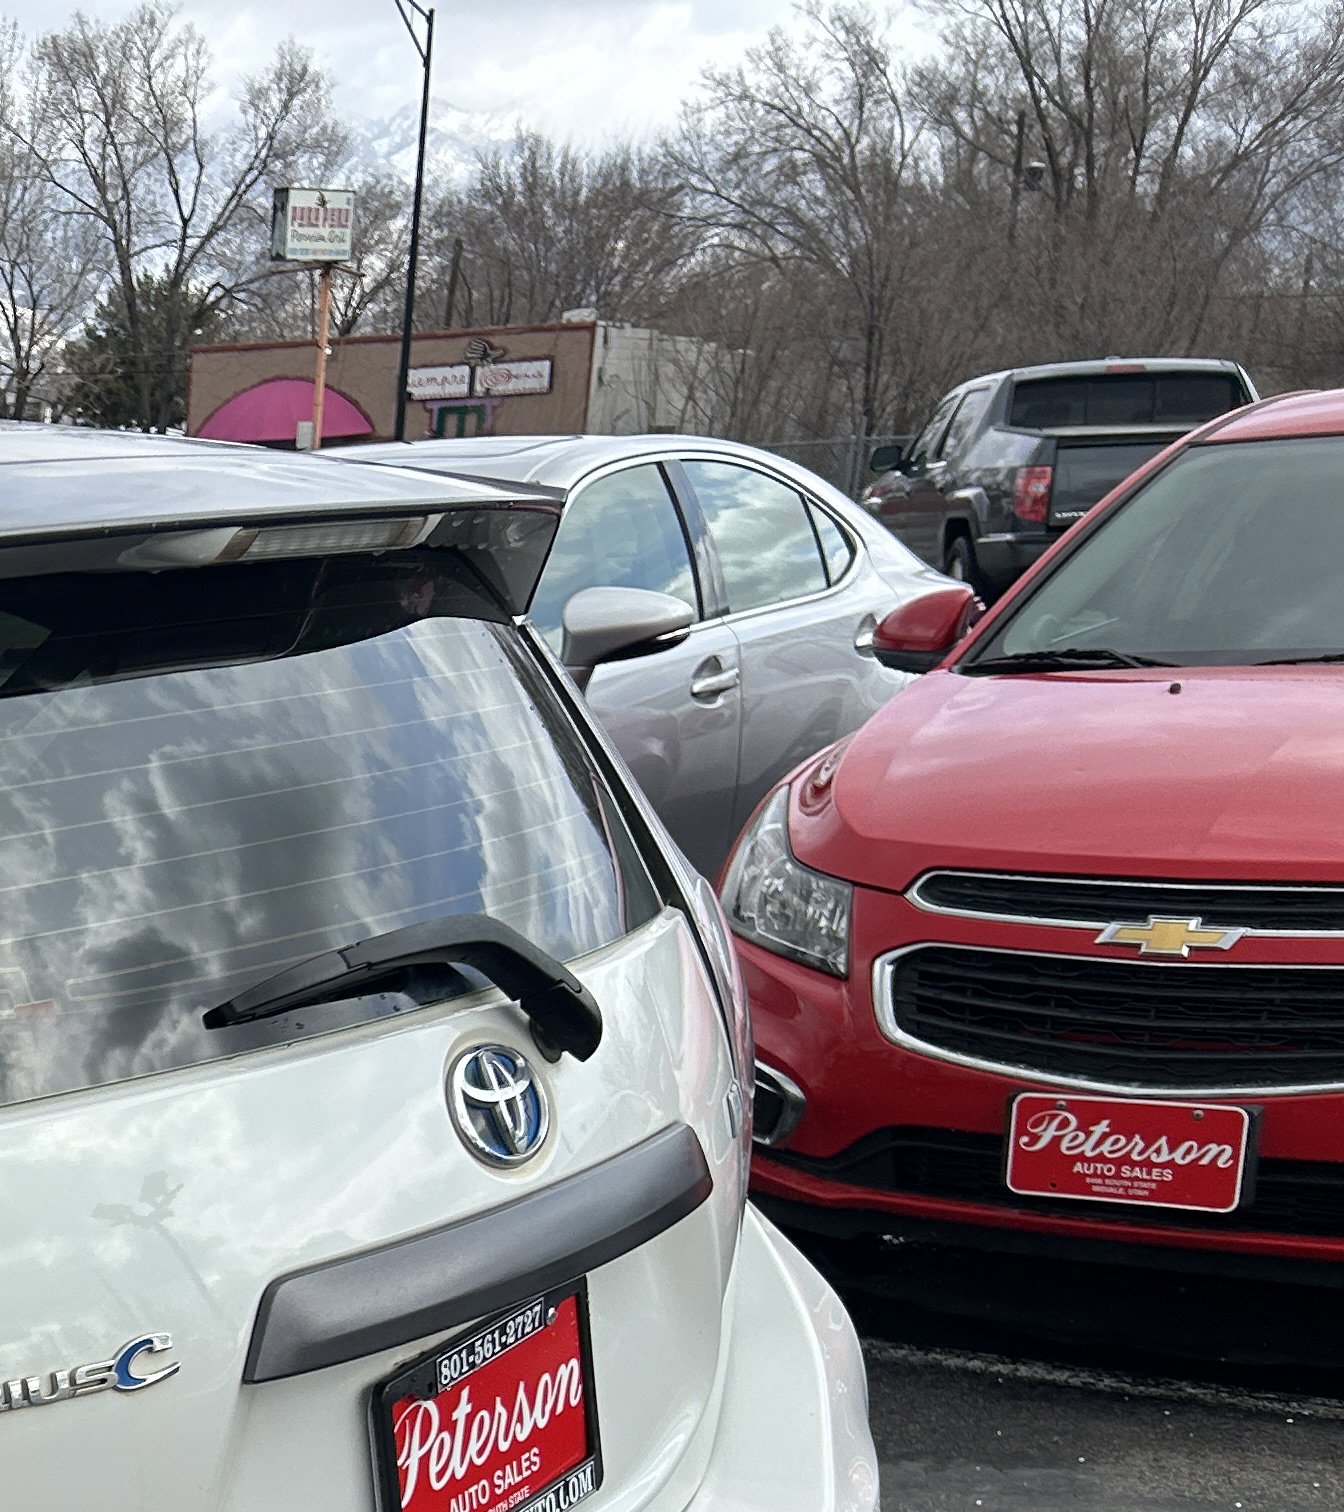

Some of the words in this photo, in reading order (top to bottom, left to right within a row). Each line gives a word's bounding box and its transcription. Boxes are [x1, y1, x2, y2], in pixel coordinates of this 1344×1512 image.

[1019, 1110, 1234, 1168] Peterson
[1072, 1161, 1116, 1177] AUTO
[1120, 1165, 1174, 1181] SALES
[440, 1305, 542, 1385] 801-561-2727
[394, 1357, 582, 1509] Peterson
[494, 1447, 541, 1495] SALES
[508, 1485, 531, 1508] STATE
